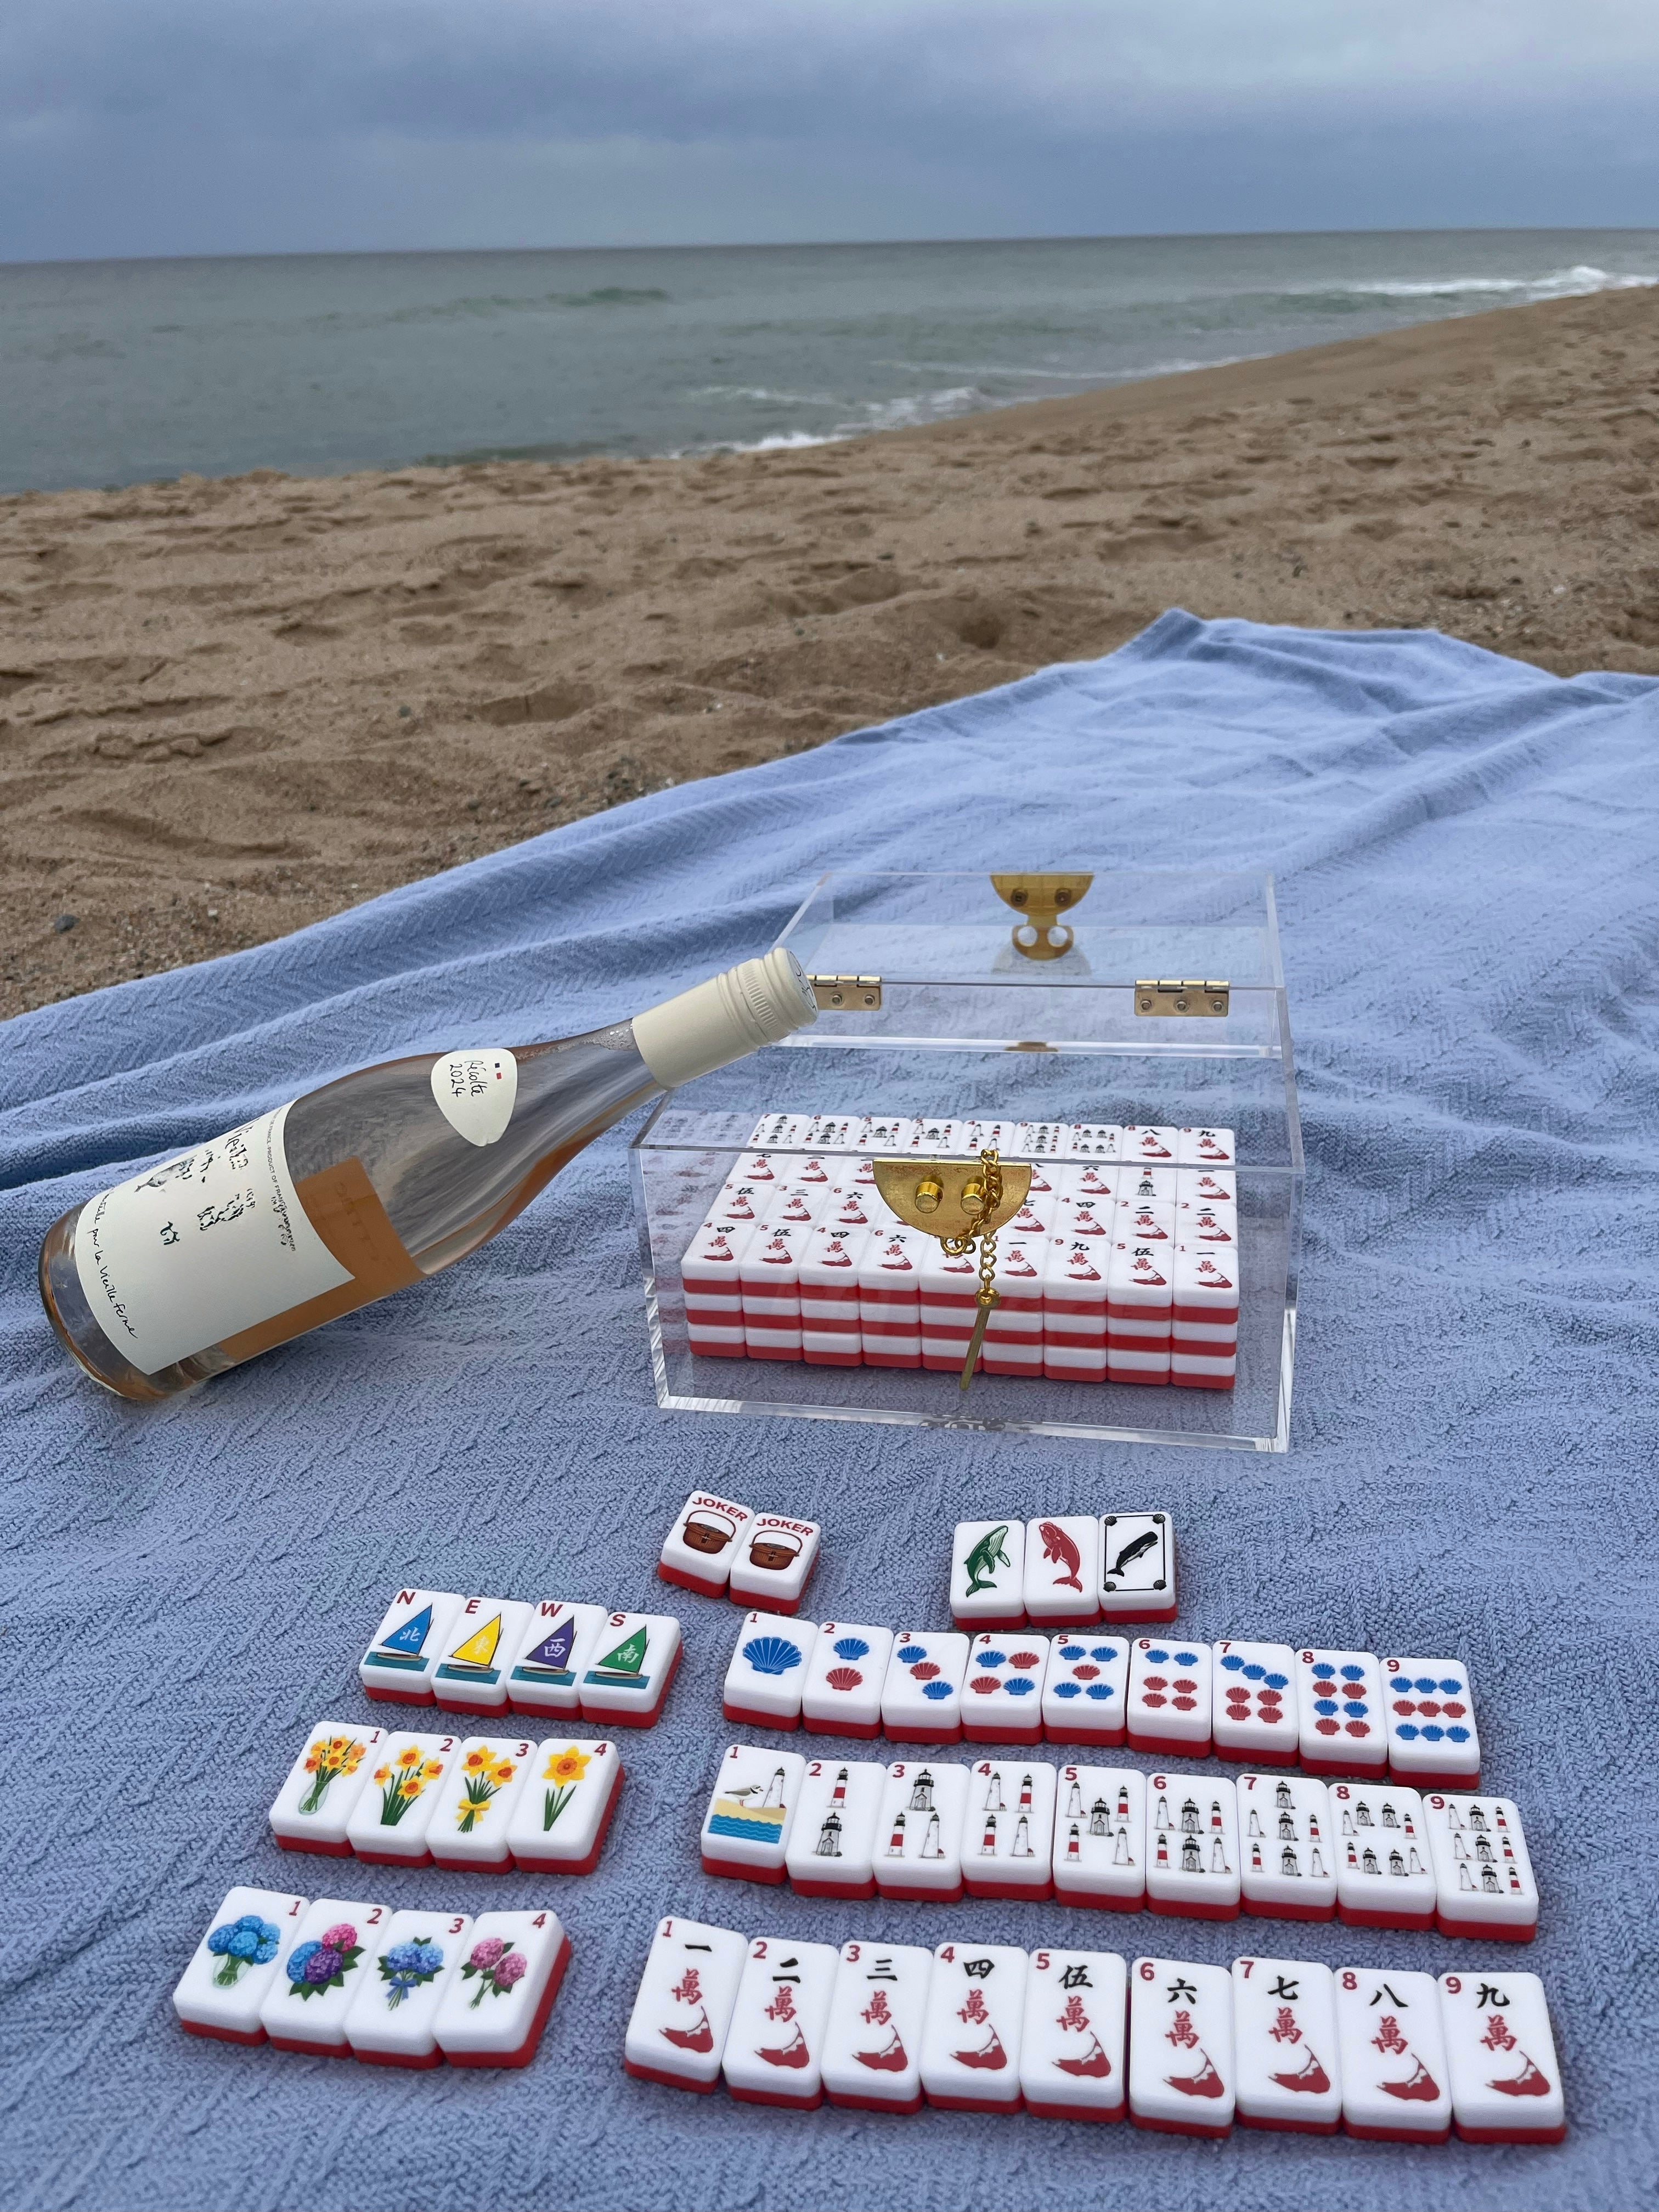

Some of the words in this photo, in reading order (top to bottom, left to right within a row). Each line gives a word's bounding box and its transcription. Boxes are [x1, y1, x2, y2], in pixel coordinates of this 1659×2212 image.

[449, 1063, 466, 1098] 2024
[692, 1497, 748, 1521] JOKER
[756, 1518, 814, 1536] JOKER
[397, 1591, 415, 1605] N
[465, 1600, 481, 1613] E
[541, 1602, 563, 1617] W
[610, 1614, 625, 1626] S
[751, 1613, 757, 1623] 1
[399, 1627, 420, 1643] 北
[824, 1623, 834, 1633] 2
[900, 1633, 910, 1643] 3
[979, 1635, 991, 1644] 4
[1058, 1635, 1068, 1644] 5
[1139, 1640, 1150, 1649] 6
[474, 1637, 490, 1655] 東
[544, 1638, 566, 1657] 西
[1220, 1642, 1231, 1653] 7
[618, 1644, 640, 1663] 南
[1302, 1651, 1314, 1663] 8
[1387, 1660, 1400, 1672] 9
[370, 1731, 380, 1743] 1
[440, 1739, 453, 1752] 2
[516, 1743, 528, 1757] 3
[595, 1743, 607, 1756] 4
[730, 1746, 738, 1758] 1
[809, 1763, 821, 1776] 2
[893, 1765, 905, 1778] 3
[978, 1763, 991, 1776] 4
[1065, 1768, 1077, 1781] 5
[1154, 1776, 1166, 1790] 6
[1244, 1777, 1256, 1790] 7
[1337, 1786, 1350, 1799] 8
[1431, 1796, 1444, 1809] 9
[289, 1901, 301, 1916] 1
[367, 1909, 382, 1924] 2
[533, 1914, 546, 1928] 4
[449, 1918, 464, 1933] 3
[663, 1921, 672, 1937] 1
[753, 1942, 767, 1959] 2
[847, 1945, 860, 1962] 3
[941, 1947, 955, 1963] 4
[1036, 1953, 1049, 1970] 5
[1141, 1962, 1154, 1980] 6
[1240, 1961, 1254, 1978] 7
[1343, 1972, 1357, 1990] 8
[1446, 1977, 1461, 1994] 9
